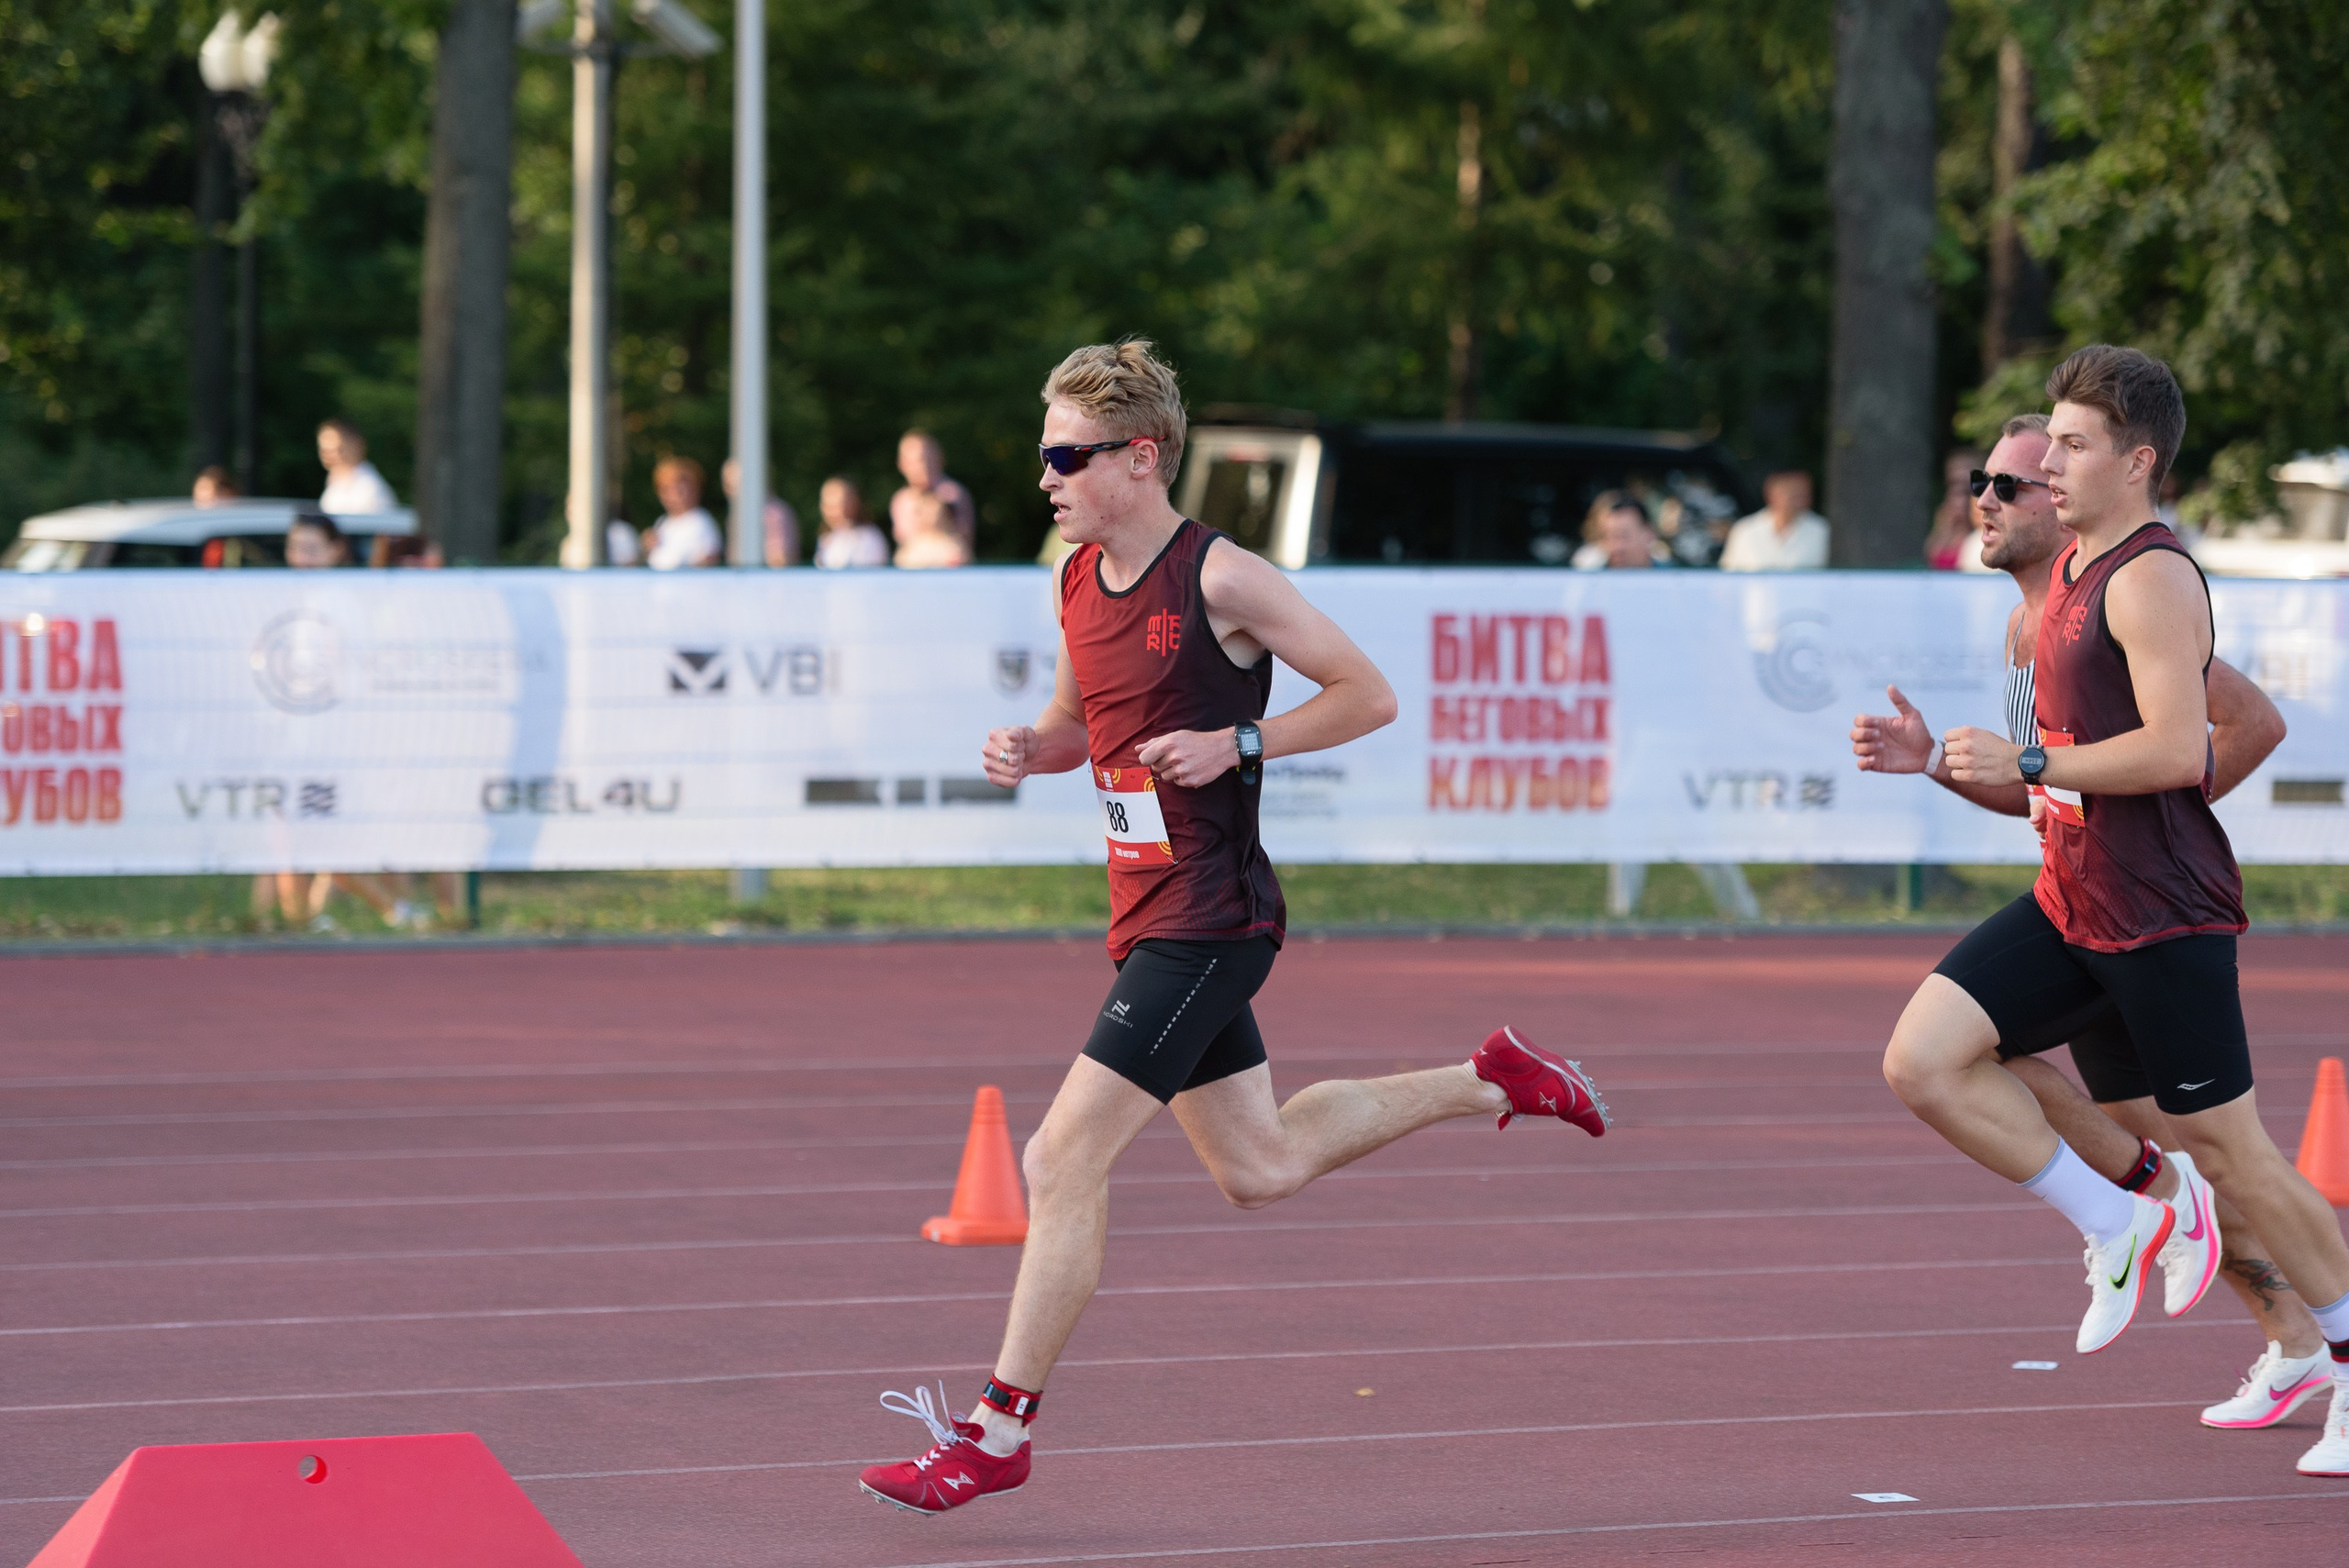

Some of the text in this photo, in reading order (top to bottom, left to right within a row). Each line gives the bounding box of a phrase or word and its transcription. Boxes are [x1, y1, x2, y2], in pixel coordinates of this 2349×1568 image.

[0, 618, 122, 691] ТВА
[740, 648, 843, 695] VBI
[1431, 614, 1611, 684] БИТВА
[1431, 696, 1611, 741] БЕГОВЫХ
[175, 776, 287, 819] VTR
[1429, 756, 1611, 811] КЛУБОВ
[1681, 770, 1790, 812] VTR
[1107, 800, 1130, 833] 88
